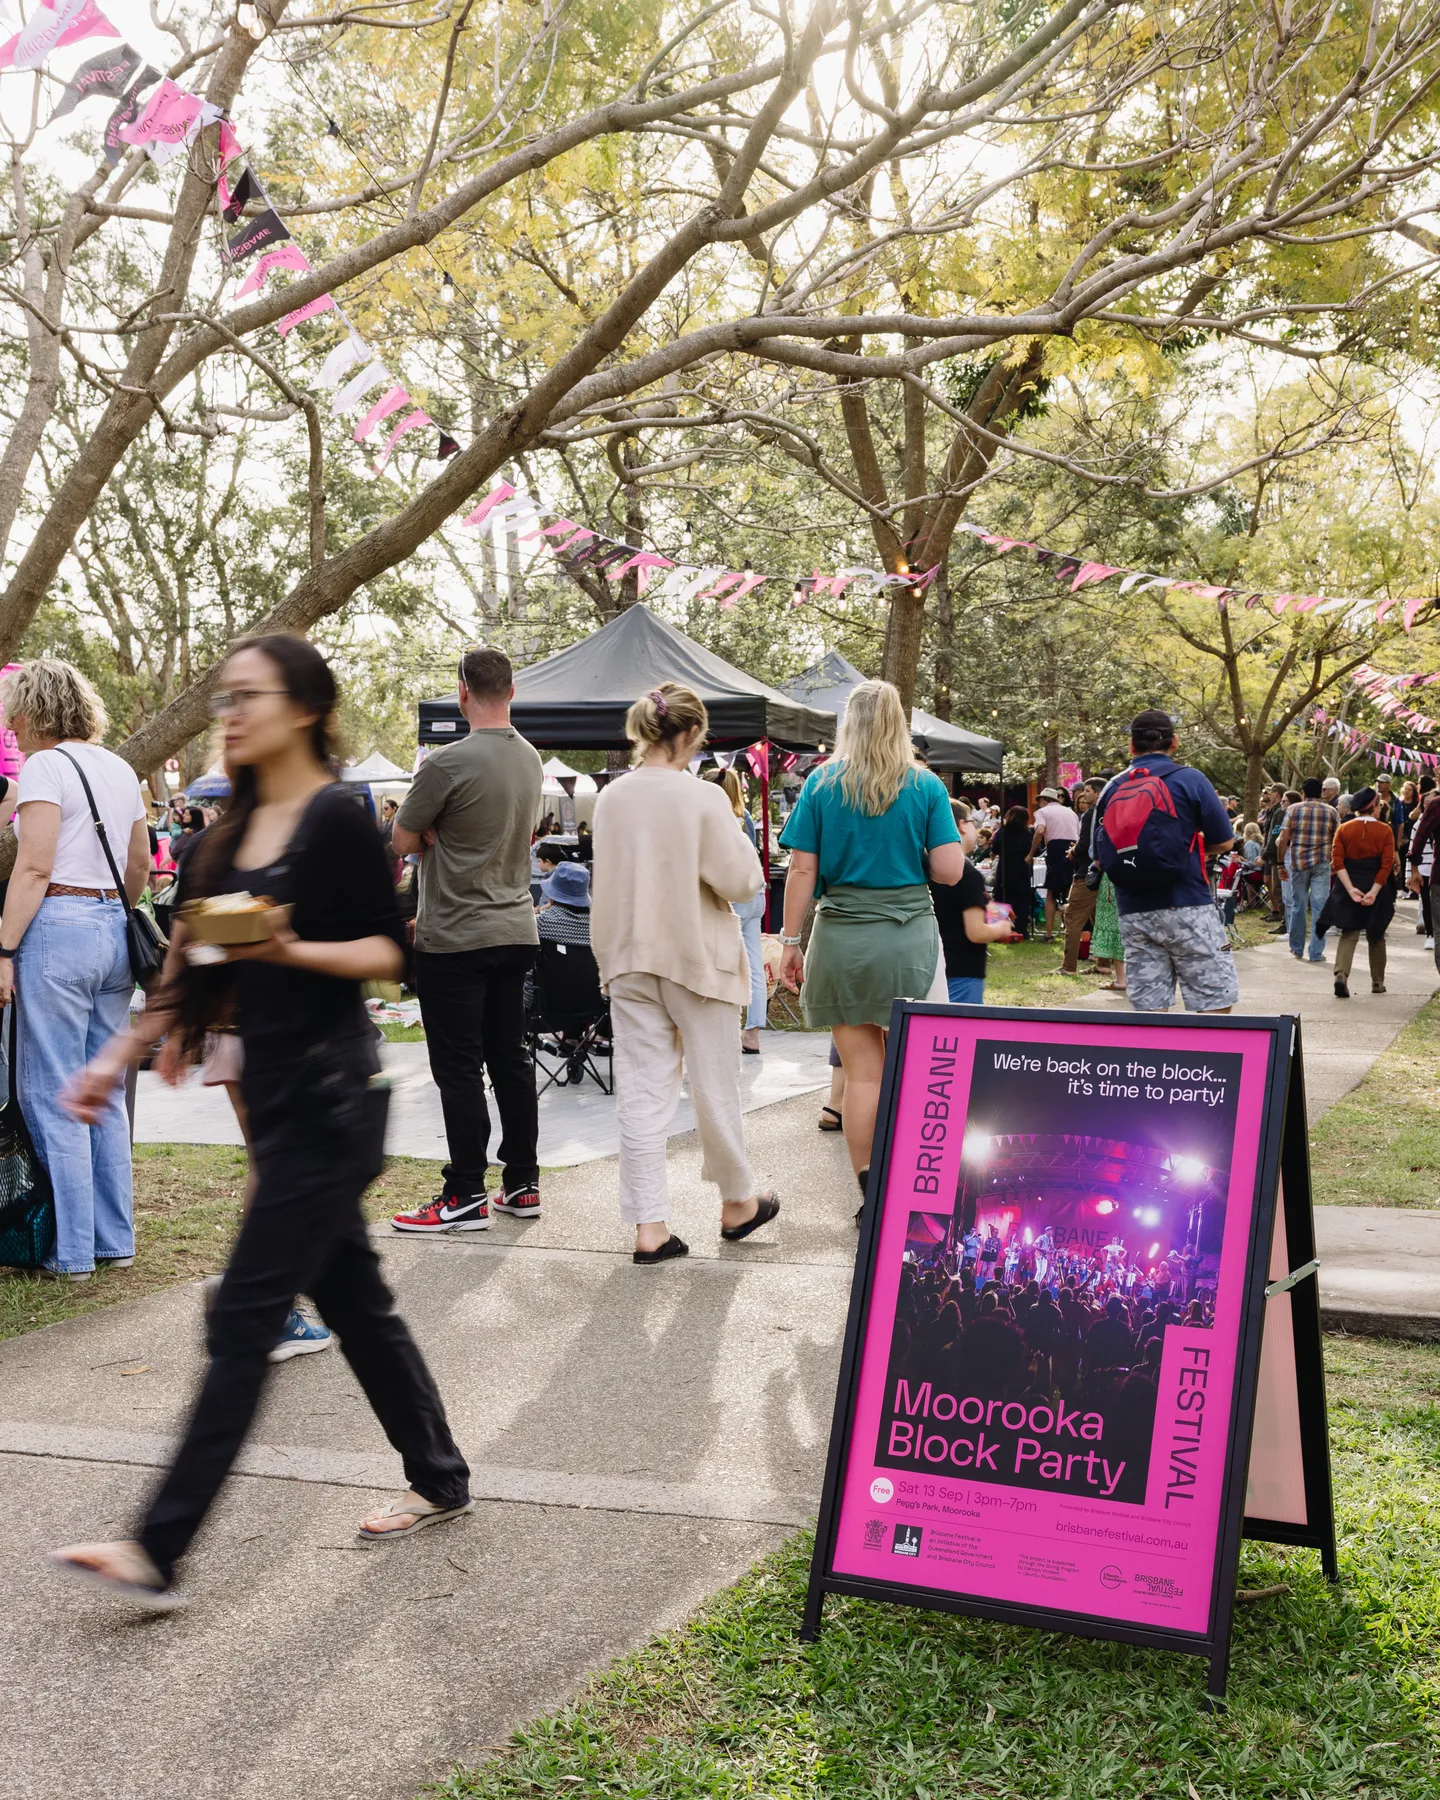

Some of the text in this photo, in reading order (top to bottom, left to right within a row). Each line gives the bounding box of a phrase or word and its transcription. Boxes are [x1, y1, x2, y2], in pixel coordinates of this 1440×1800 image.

[994, 1053, 1227, 1083] We’re back on the block...
[1068, 1078, 1225, 1107] it’s time to party!
[913, 1035, 959, 1194] BRISBANE
[518, 1193, 540, 1206] NIK
[894, 1378, 1105, 1441] Moorooka
[1165, 1346, 1211, 1510] FESTIVAL
[888, 1420, 1127, 1496] Block Party
[873, 1485, 891, 1495] Free
[899, 1481, 919, 1495] Sat
[924, 1485, 935, 1496] 13
[939, 1487, 963, 1502] Sep
[922, 1503, 941, 1513] Park,
[943, 1505, 980, 1518] Moorooka
[1060, 1504, 1083, 1512] Presented
[1091, 1508, 1111, 1516] Brisbane
[1112, 1511, 1130, 1519] Festival
[1141, 1515, 1161, 1523] Brisbane
[1162, 1518, 1172, 1526] City
[930, 1530, 954, 1538] Brisbane
[955, 1533, 976, 1542] Festival
[937, 1539, 960, 1547] initiative
[1056, 1521, 1188, 1550] brisbanefestival.com.au
[928, 1545, 993, 1560] Queensland Government
[939, 1555, 962, 1564] Brisbane
[963, 1558, 974, 1567] City
[975, 1561, 995, 1569] Council
[1019, 1560, 1036, 1568] through
[1061, 1565, 1080, 1573] Program
[1030, 1555, 1046, 1563] project
[1052, 1558, 1075, 1567] supported
[1042, 1567, 1059, 1575] Vincent
[1135, 1573, 1175, 1587] BRISBANE
[1148, 1583, 1183, 1597] FESTIVAL
